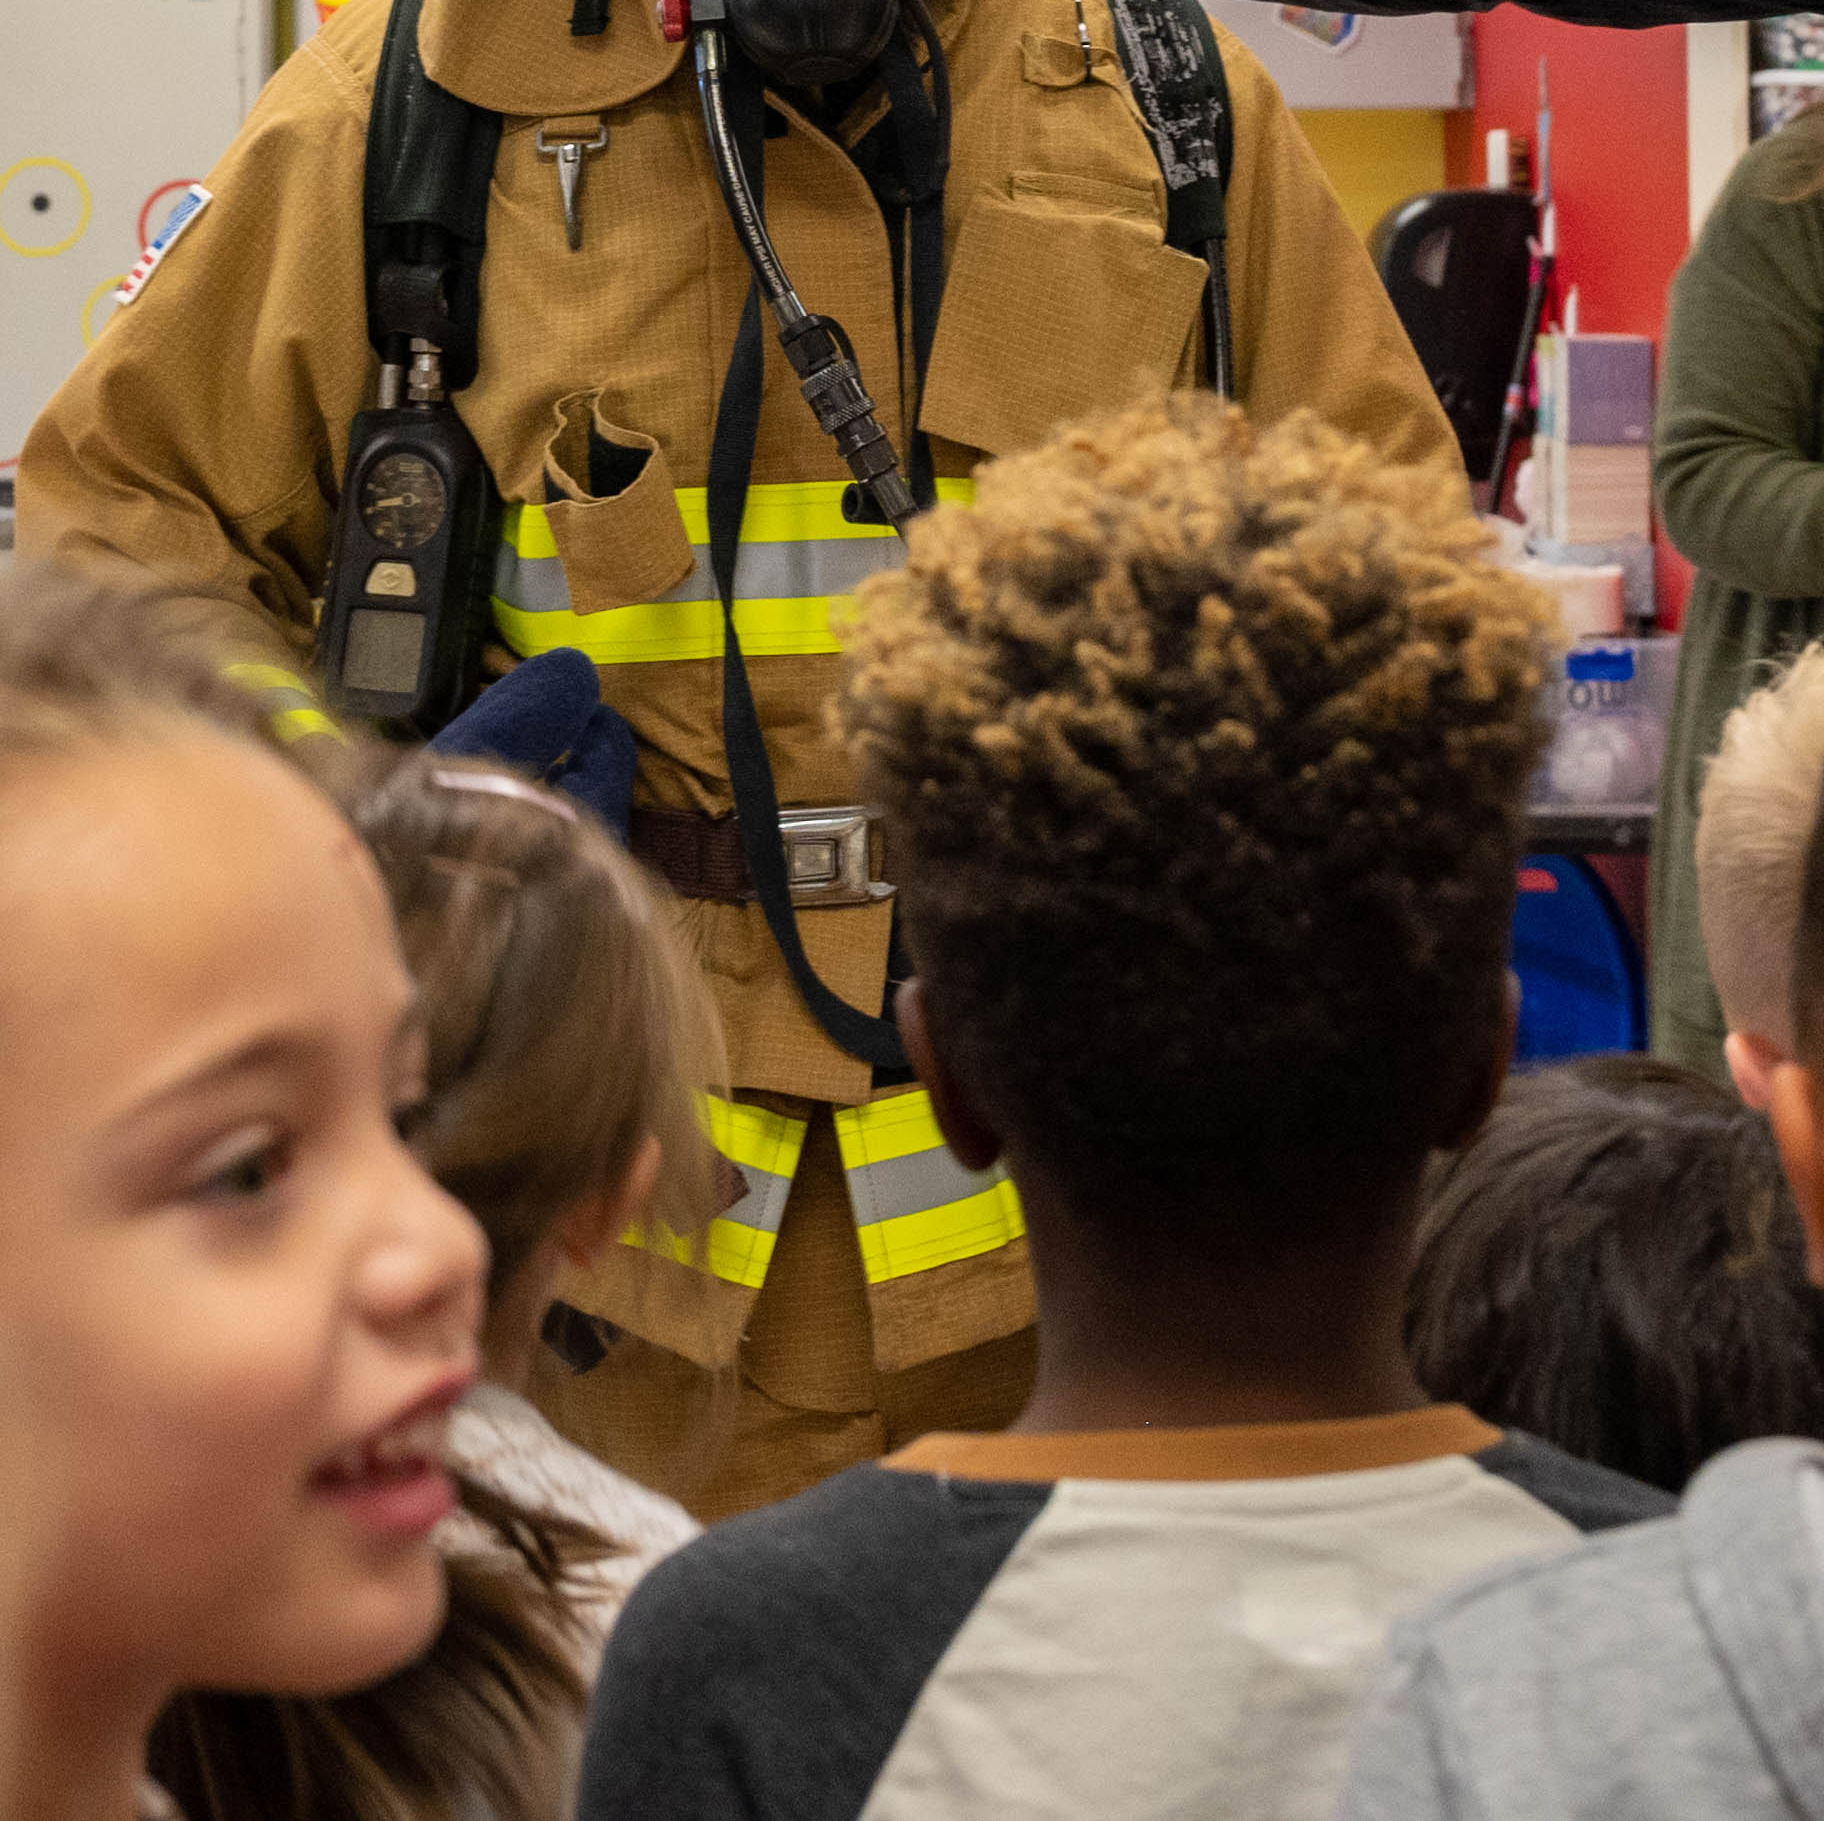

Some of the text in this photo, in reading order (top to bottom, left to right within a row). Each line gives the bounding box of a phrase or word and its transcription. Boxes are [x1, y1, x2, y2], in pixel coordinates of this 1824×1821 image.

[733, 190, 754, 224] CAUSE
[746, 225, 762, 245] MAY
[756, 244, 769, 261] PSI
